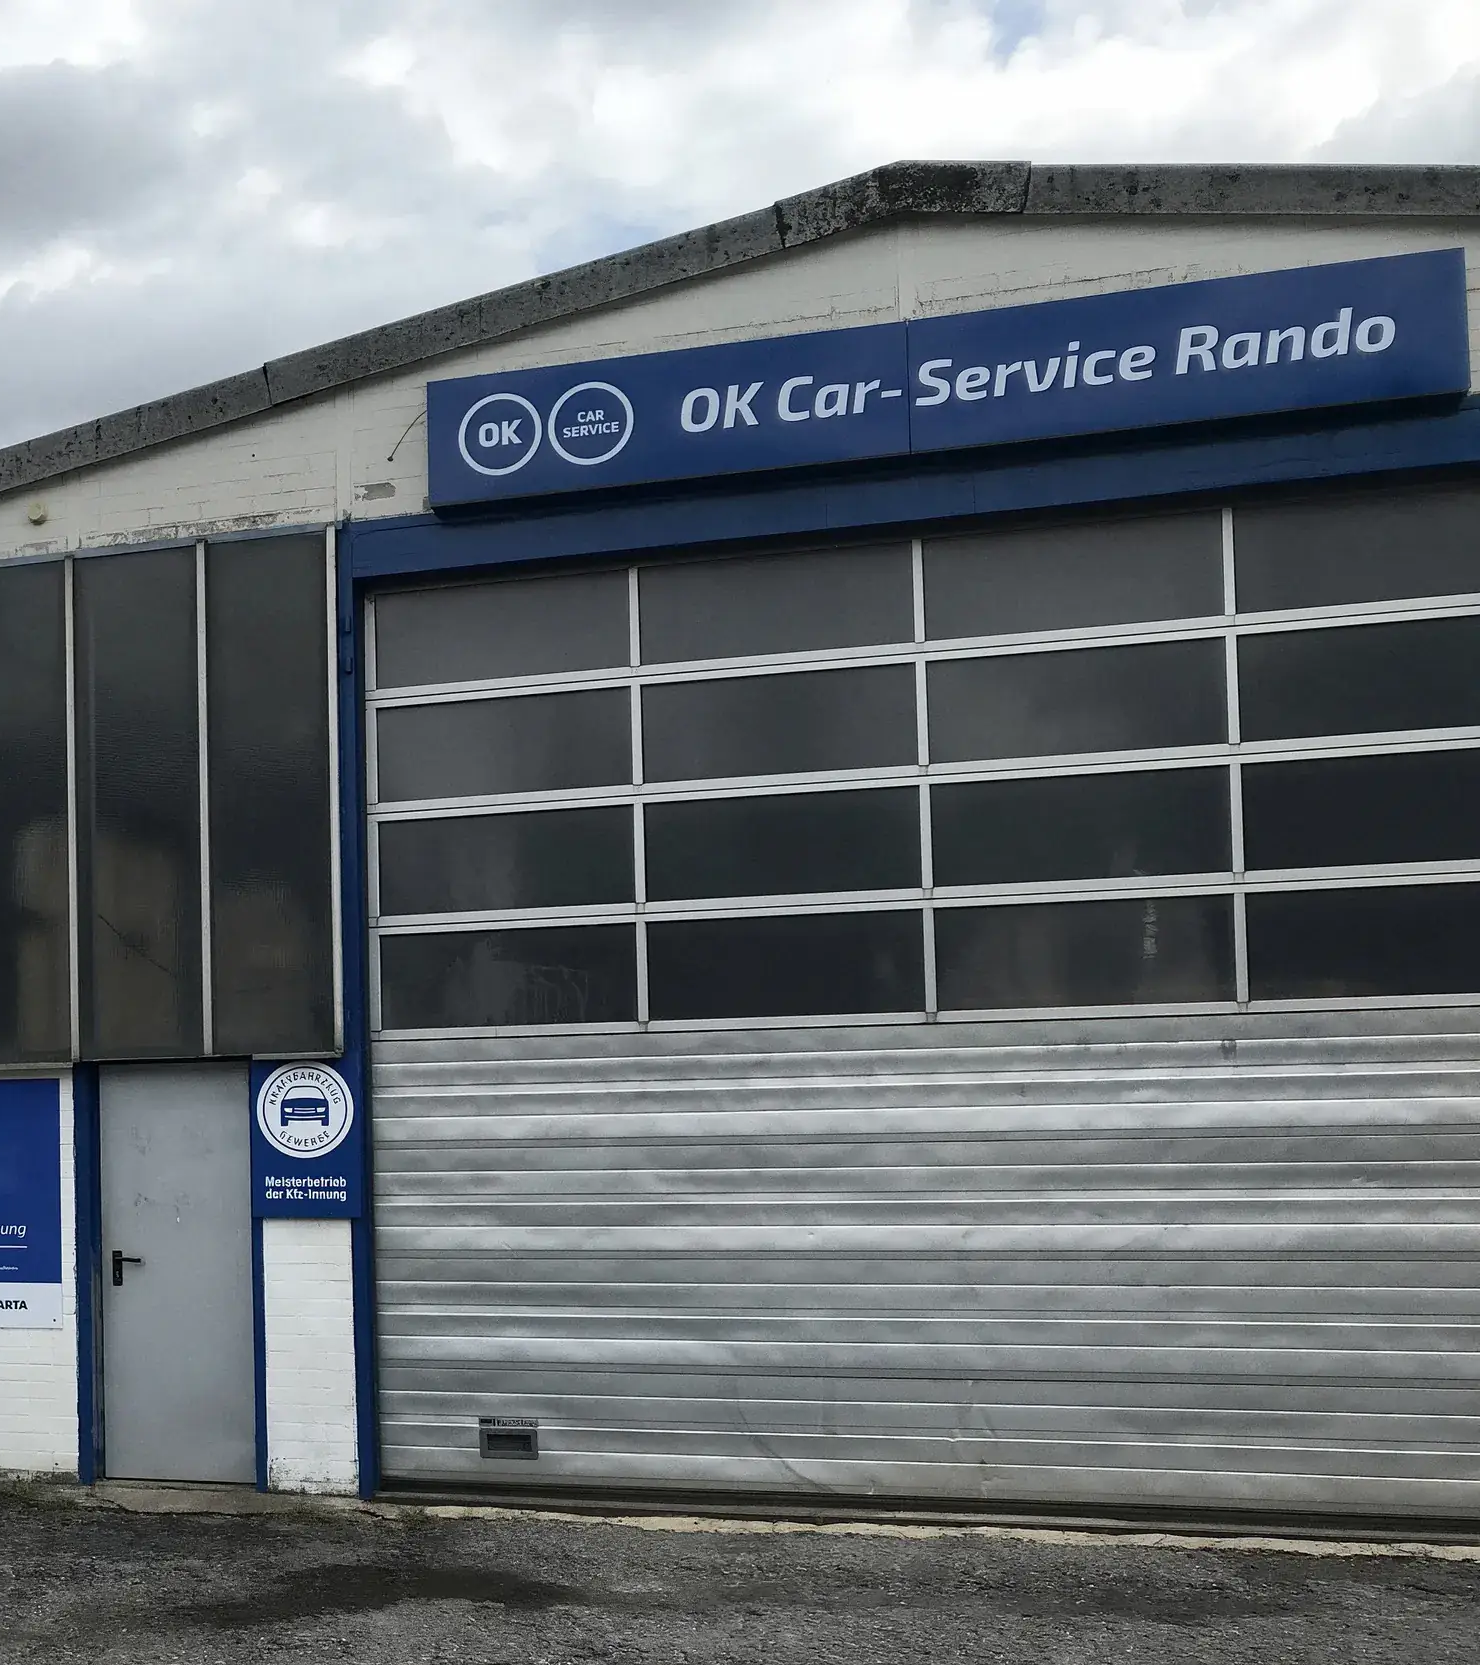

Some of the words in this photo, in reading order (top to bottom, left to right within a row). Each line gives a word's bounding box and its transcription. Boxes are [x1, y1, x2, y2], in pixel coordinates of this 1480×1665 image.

[680, 381, 764, 433] OK
[1175, 307, 1397, 375] Rando
[576, 408, 605, 423] CAR
[478, 418, 523, 448] OK
[562, 420, 620, 438] SERVICE
[279, 1130, 330, 1147] GEWERBE
[265, 1175, 347, 1188] Meisterbetrieb
[265, 1189, 284, 1200] der
[285, 1188, 347, 1202] Kfz-Innung
